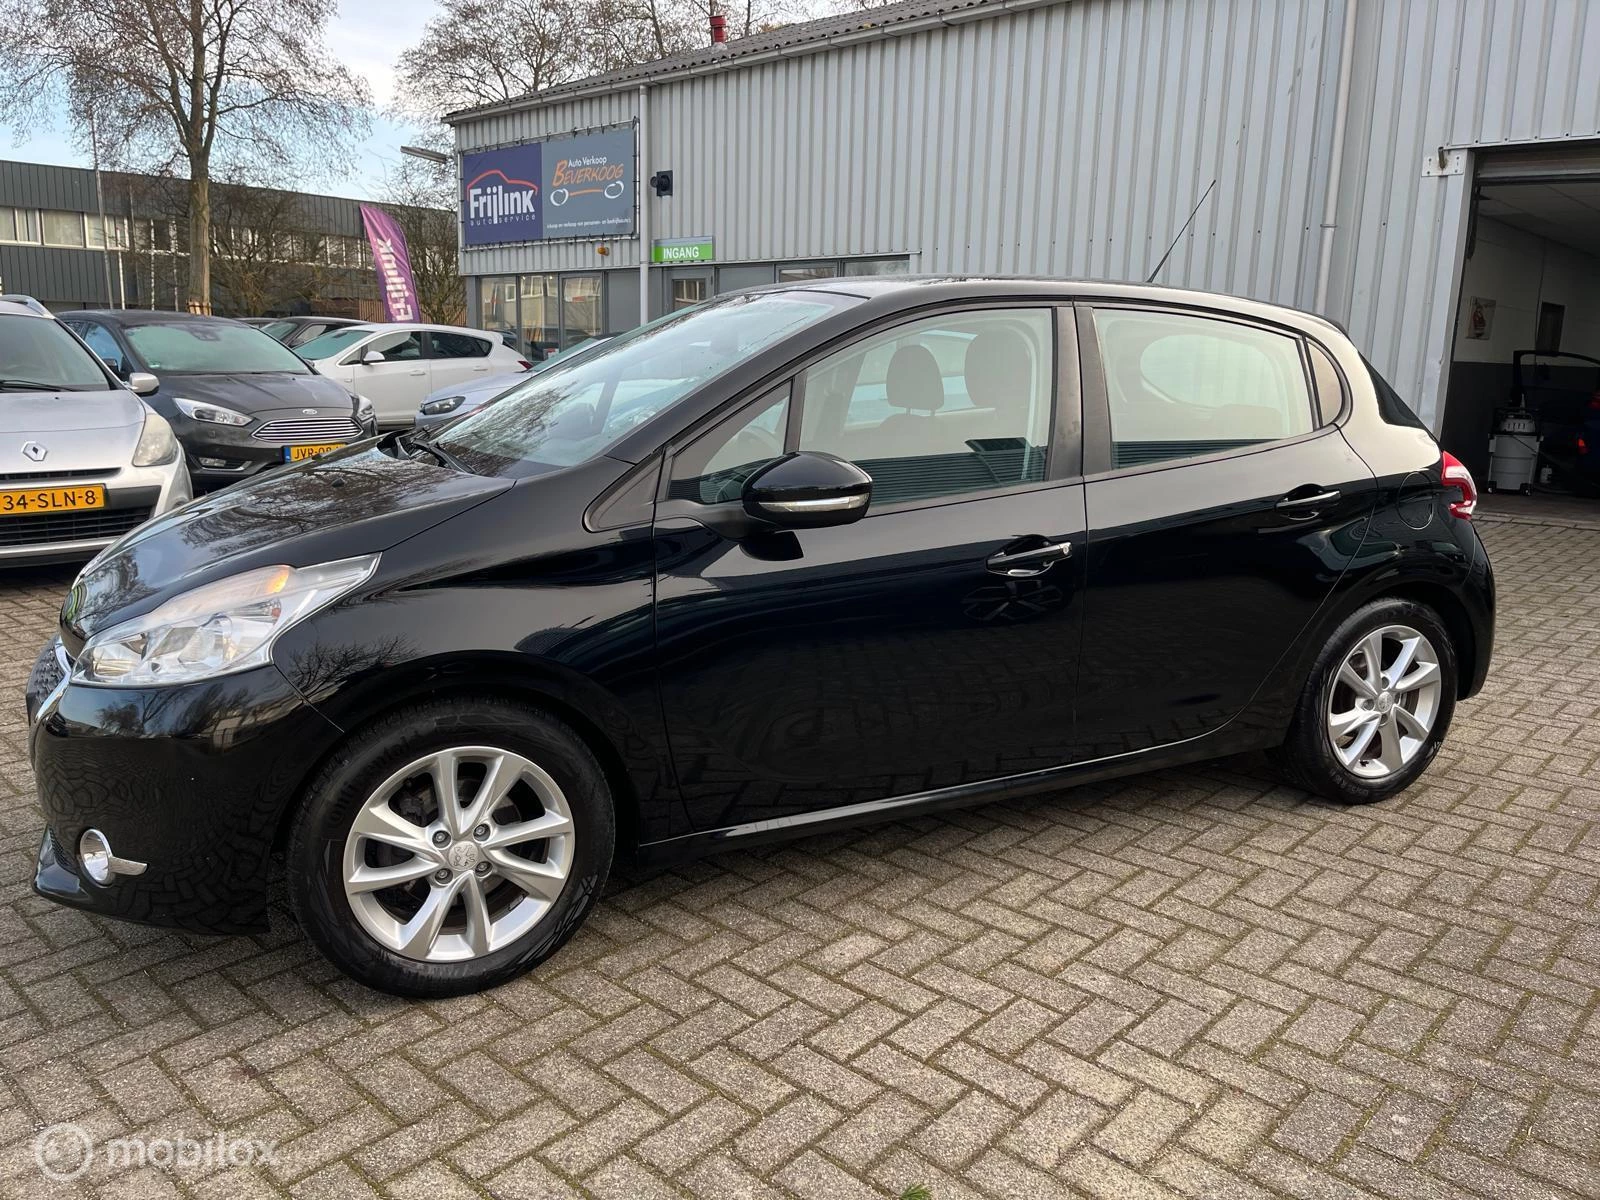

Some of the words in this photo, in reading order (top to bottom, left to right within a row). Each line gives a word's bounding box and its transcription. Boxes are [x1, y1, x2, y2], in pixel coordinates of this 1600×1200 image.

[568, 159, 582, 168] Auto
[583, 155, 607, 166] Verkoop
[552, 160, 624, 188] BEVERKOOG
[469, 185, 535, 224] Frijlink
[663, 246, 700, 260] INGANG
[3, 490, 96, 511] 34-SLN-8
